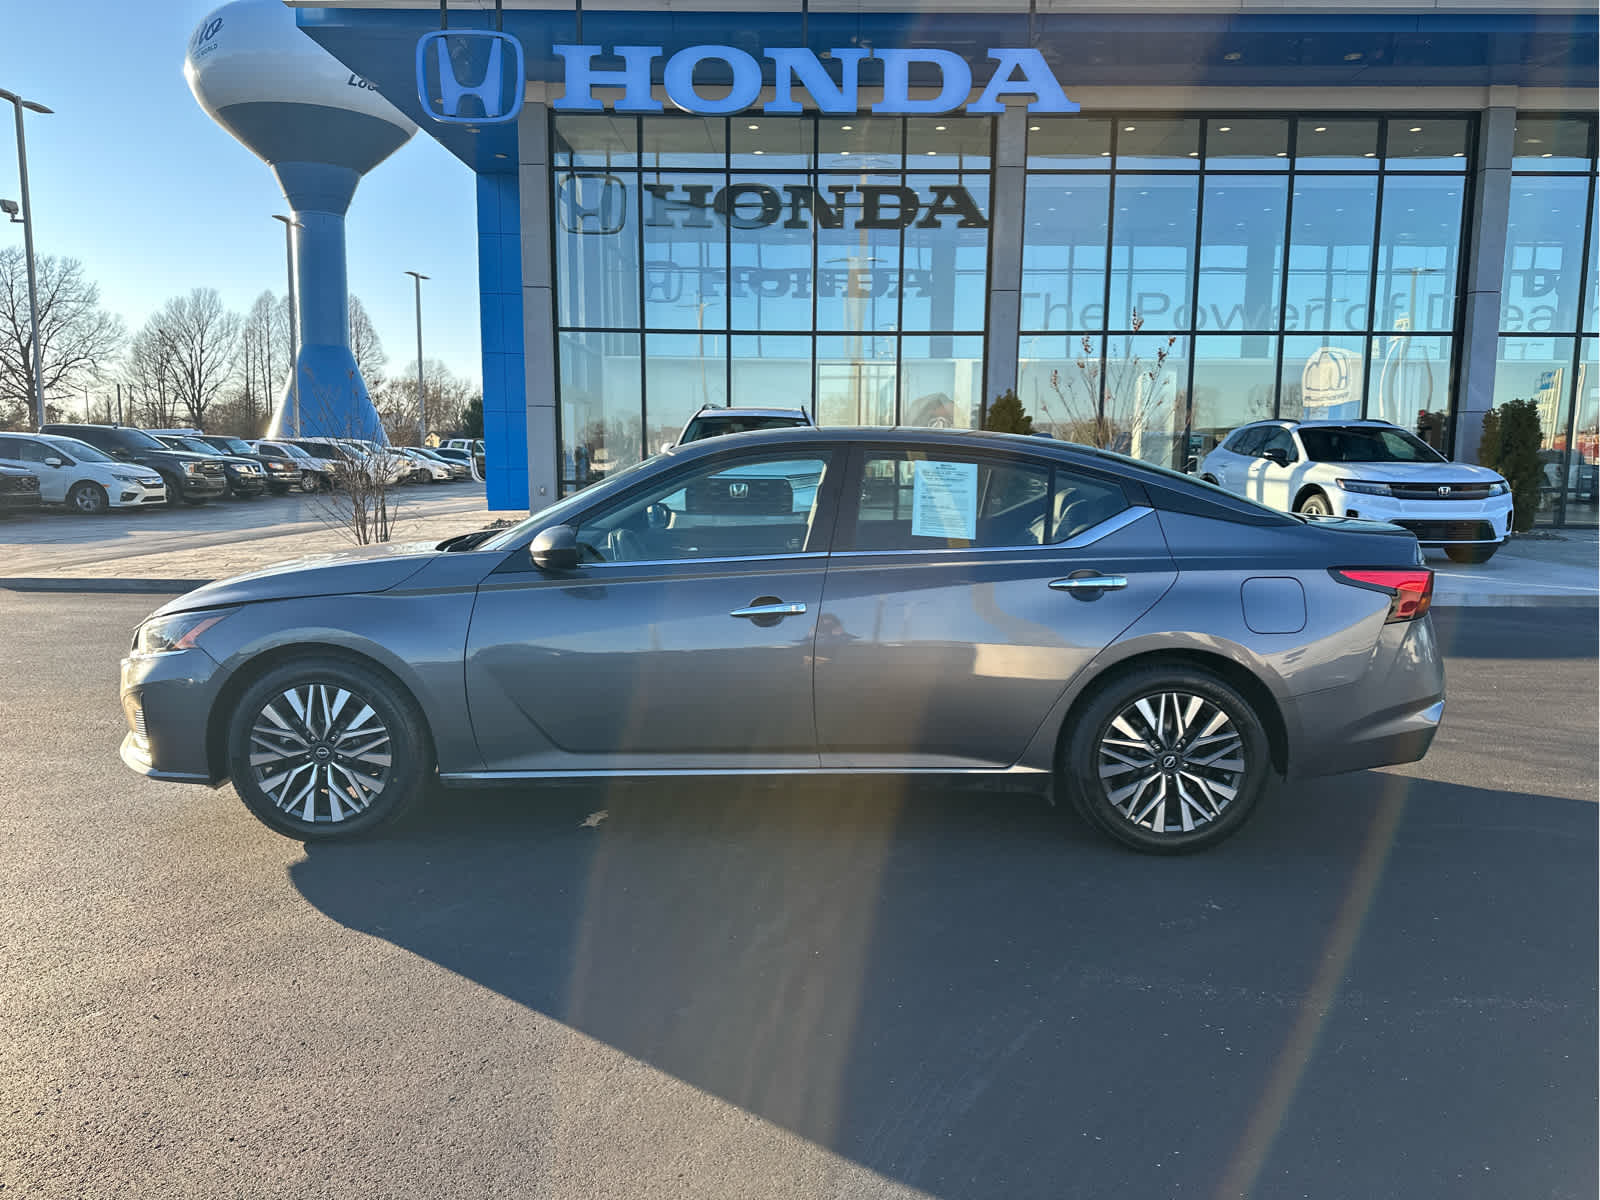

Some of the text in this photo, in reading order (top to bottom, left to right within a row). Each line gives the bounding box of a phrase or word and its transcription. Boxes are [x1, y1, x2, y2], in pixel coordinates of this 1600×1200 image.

[552, 44, 1081, 115] HONDA
[643, 183, 990, 230] HONDA
[1136, 292, 1322, 332] Power
